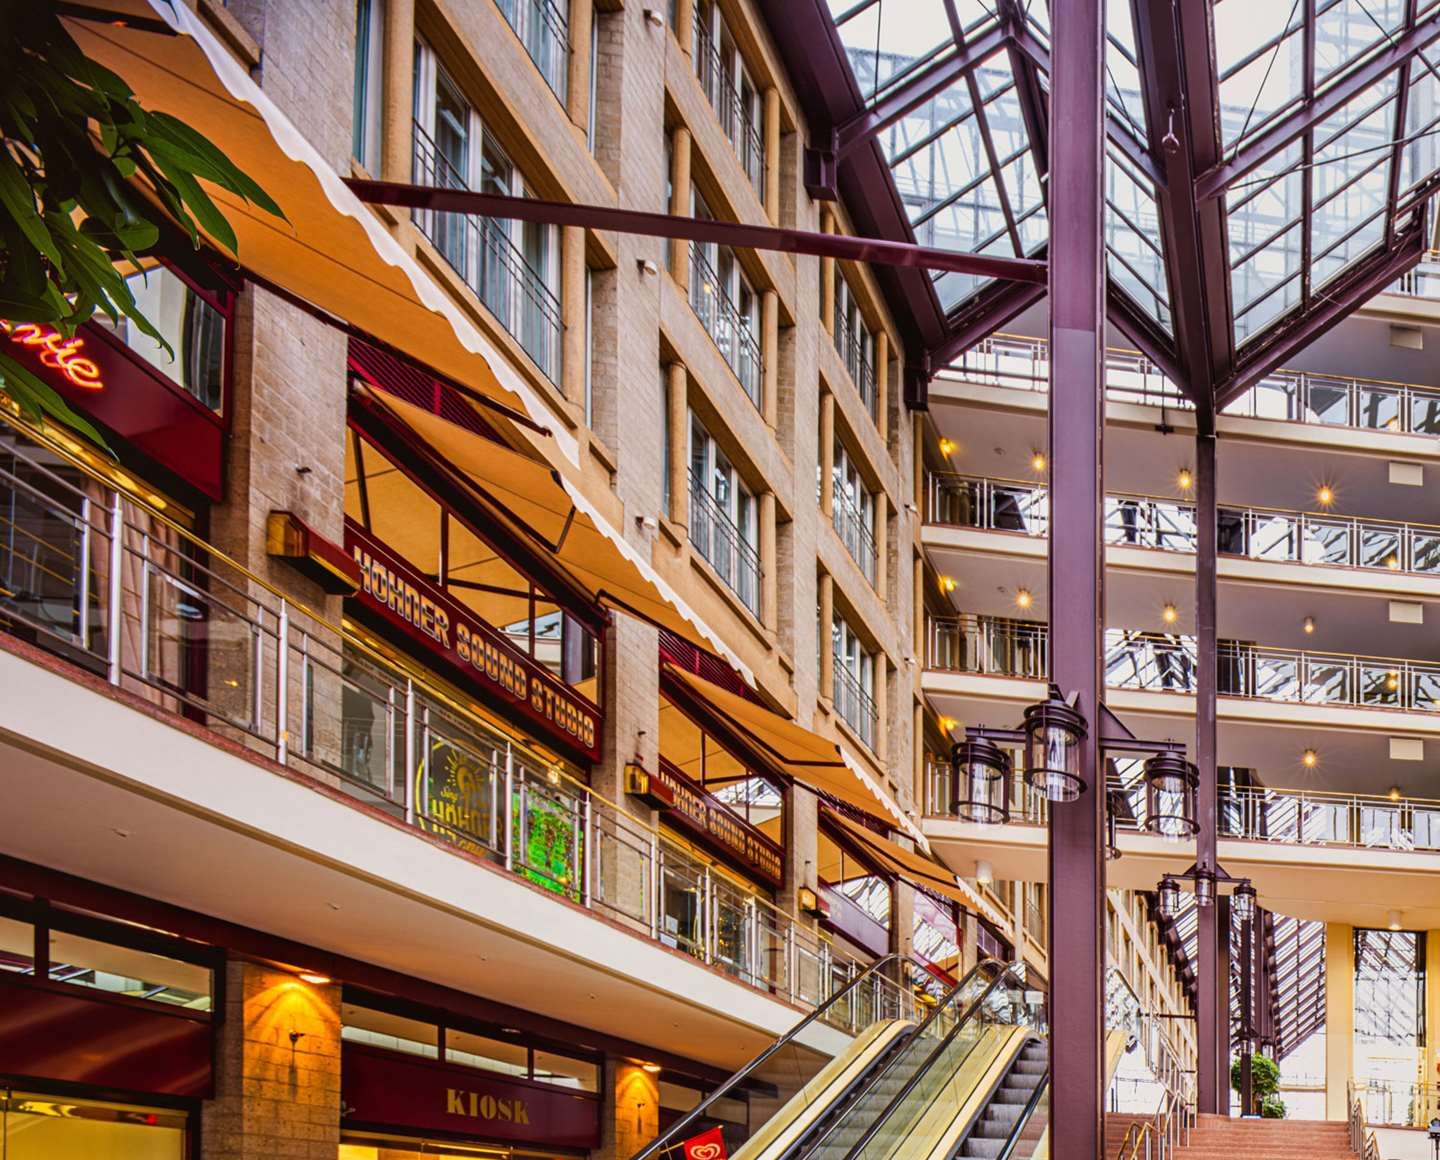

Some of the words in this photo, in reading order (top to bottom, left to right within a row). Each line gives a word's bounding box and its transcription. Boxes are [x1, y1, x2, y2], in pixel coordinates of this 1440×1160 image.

[353, 545, 451, 650] HÖHNER
[456, 622, 528, 701] SOUND
[530, 676, 596, 750] STUDIO
[709, 807, 746, 856] SOUND
[746, 834, 781, 881] STUDIO
[446, 1088, 530, 1125] KIOSK
